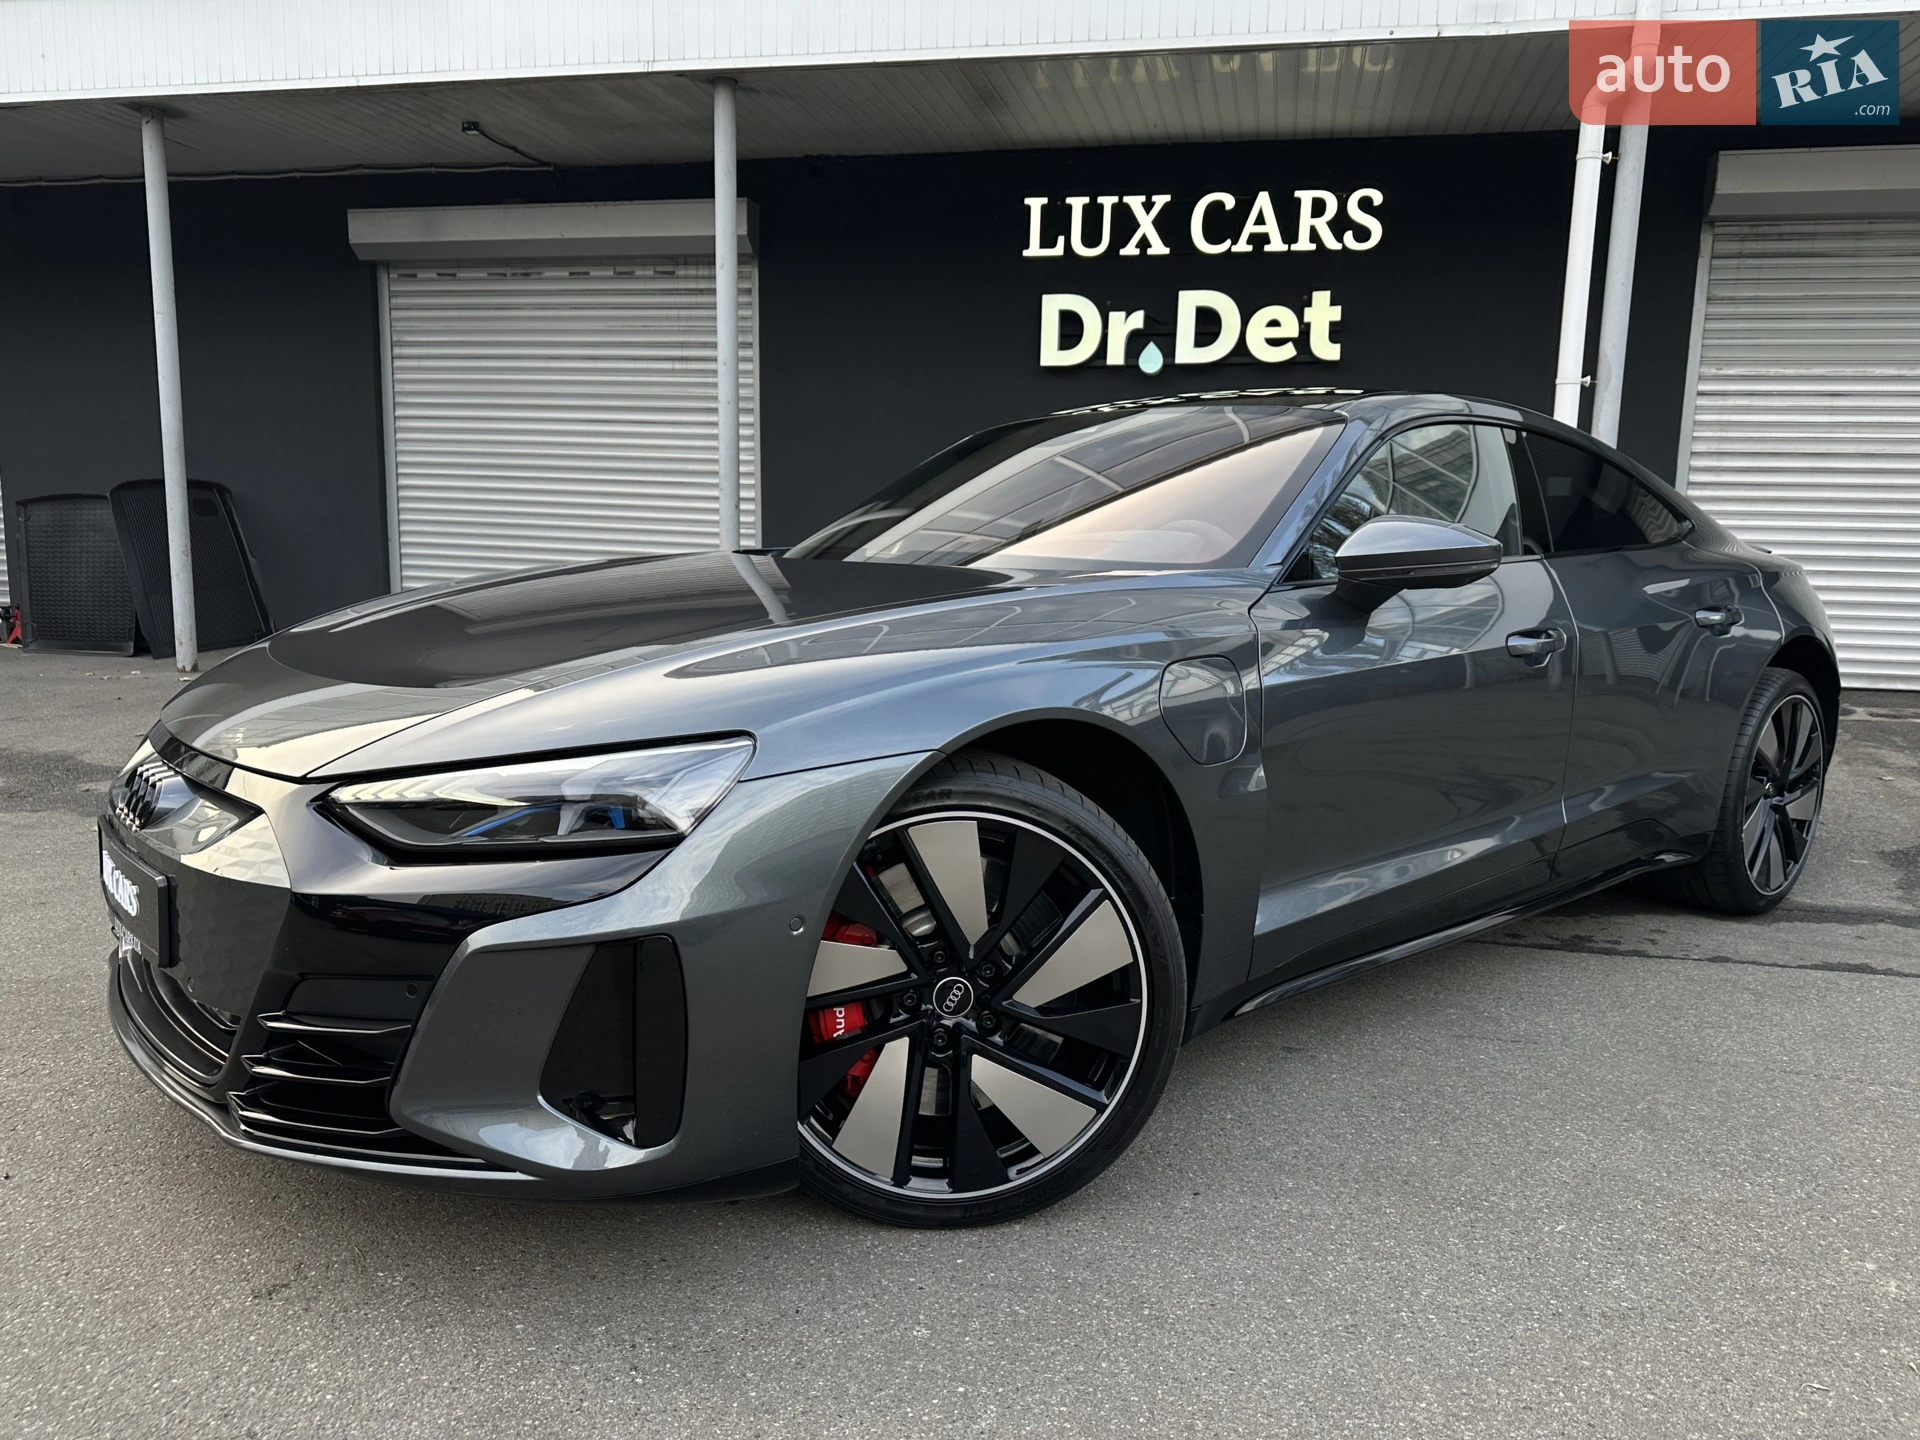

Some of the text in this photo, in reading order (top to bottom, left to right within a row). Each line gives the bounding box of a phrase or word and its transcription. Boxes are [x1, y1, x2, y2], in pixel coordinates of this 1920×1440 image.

[1022, 187, 1384, 258] LUX CARS
[1174, 289, 1343, 365] Det
[832, 1007, 846, 1039] Aud
